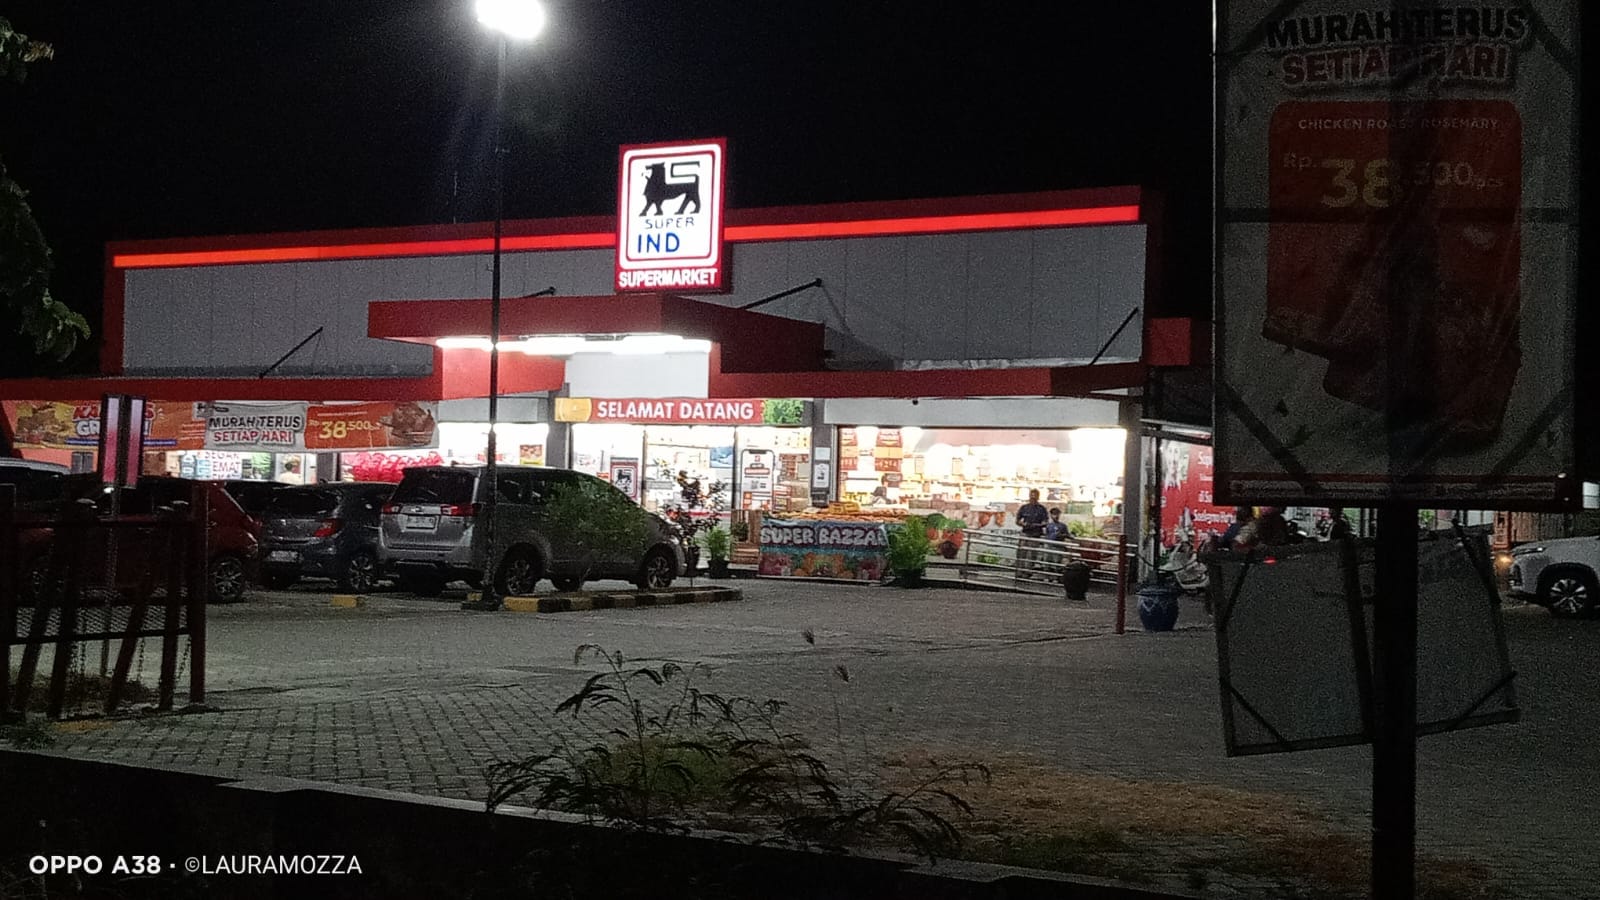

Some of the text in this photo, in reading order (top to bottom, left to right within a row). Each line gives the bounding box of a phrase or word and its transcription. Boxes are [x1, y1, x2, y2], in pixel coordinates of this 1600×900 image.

[1265, 8, 1523, 48] MURAH TERUS
[1282, 48, 1407, 83] SETIAP
[1298, 119, 1362, 129] CHICKEN
[1420, 118, 1499, 129] ROSEMARY
[645, 216, 694, 229] SUPER
[637, 232, 680, 253] IND
[619, 268, 718, 286] SUPERMARKET
[597, 400, 754, 419] SELAMAT DATANG
[208, 415, 301, 428] MURAH TERUS
[214, 430, 257, 442] SETIAP
[261, 430, 292, 442] HARI
[212, 461, 241, 472] EMAT
[760, 527, 813, 545] SUPER
